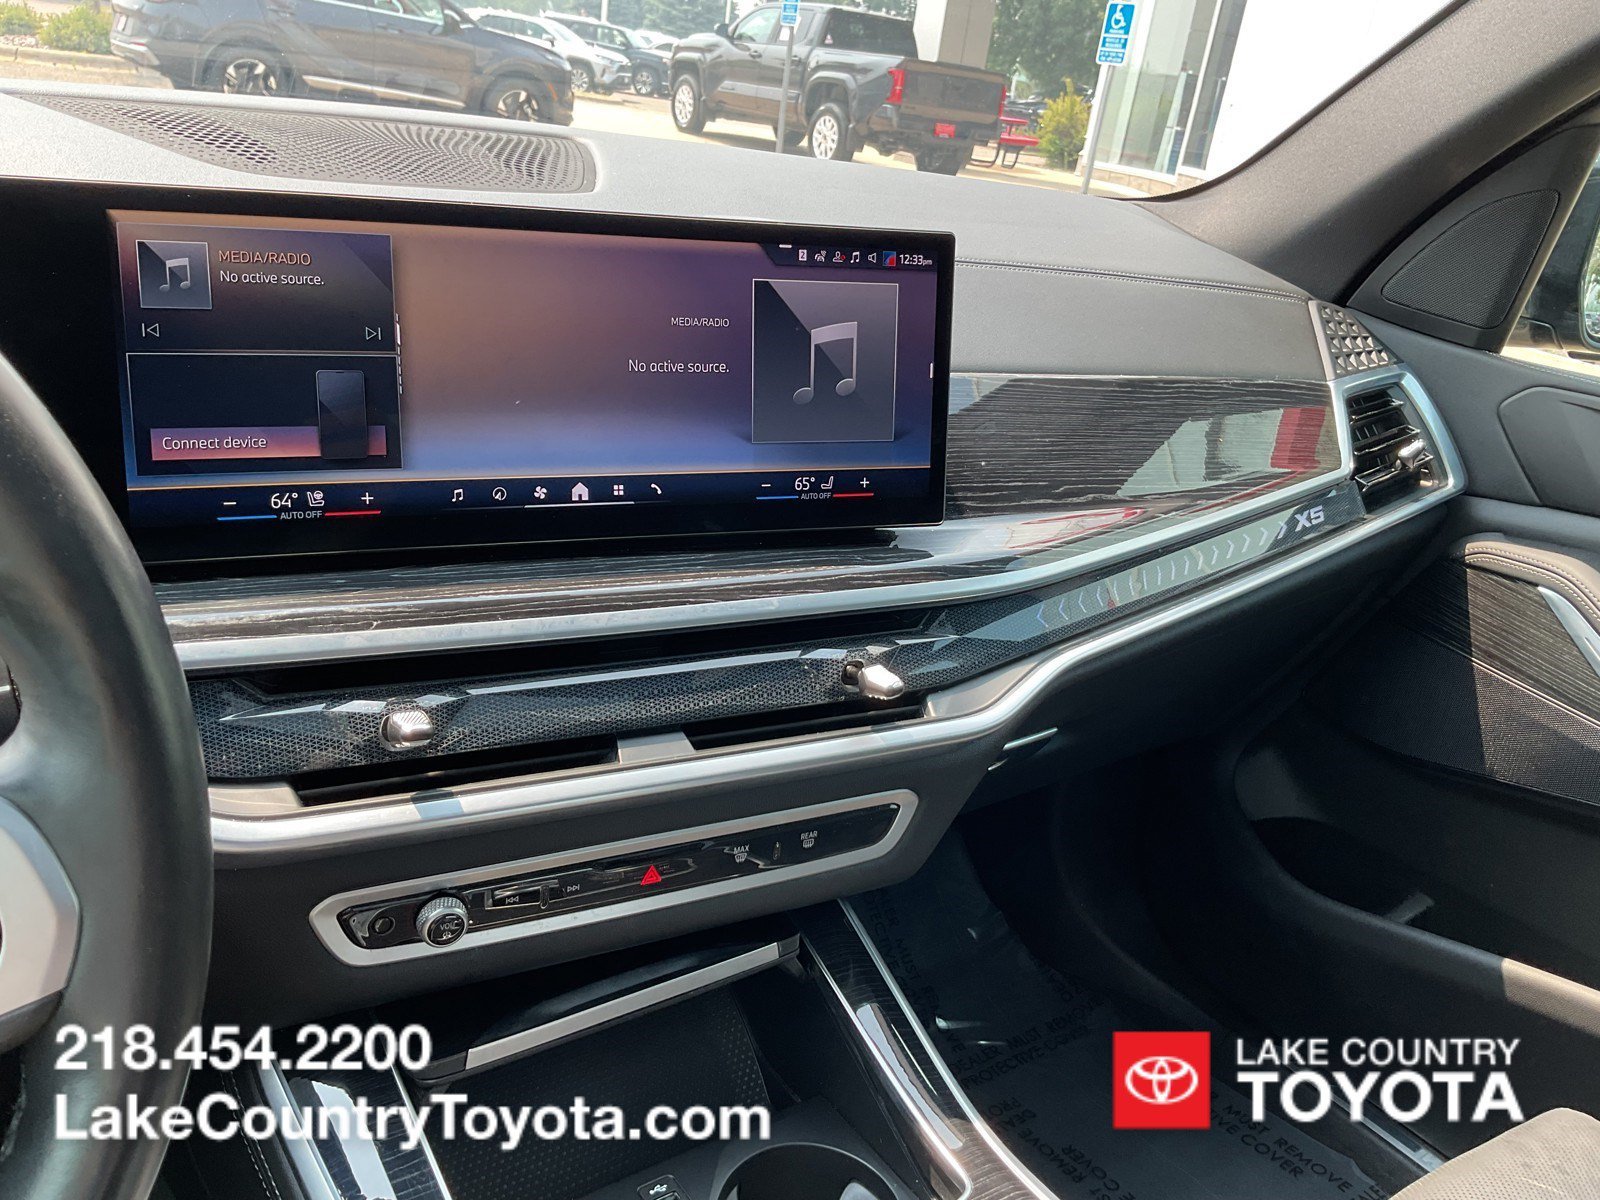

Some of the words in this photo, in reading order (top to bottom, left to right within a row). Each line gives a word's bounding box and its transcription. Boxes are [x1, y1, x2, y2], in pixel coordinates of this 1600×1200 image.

[218, 250, 311, 266] MEDIA/RADIO
[899, 253, 933, 266] 12:33pm
[220, 270, 239, 283] No
[241, 271, 278, 284] active
[280, 274, 325, 286] source.
[671, 317, 730, 327] MEDIA/RADIO
[628, 359, 646, 372] No
[649, 360, 685, 373] active
[687, 361, 730, 373] source.
[162, 436, 220, 450] Connect
[223, 435, 267, 449] device
[794, 476, 816, 491] 65°
[271, 492, 299, 509] 64°
[800, 492, 819, 500] AUTO
[280, 511, 304, 520] AUTO
[305, 510, 323, 519] OFF
[1294, 504, 1325, 533] X5
[800, 830, 818, 841] REAR
[733, 844, 750, 855] MAX
[1017, 1127, 1088, 1184] REMOVE
[1239, 1133, 1305, 1181] COVER
[1060, 1143, 1121, 1193] COVER
[1272, 1136, 1354, 1194] REMOVE
